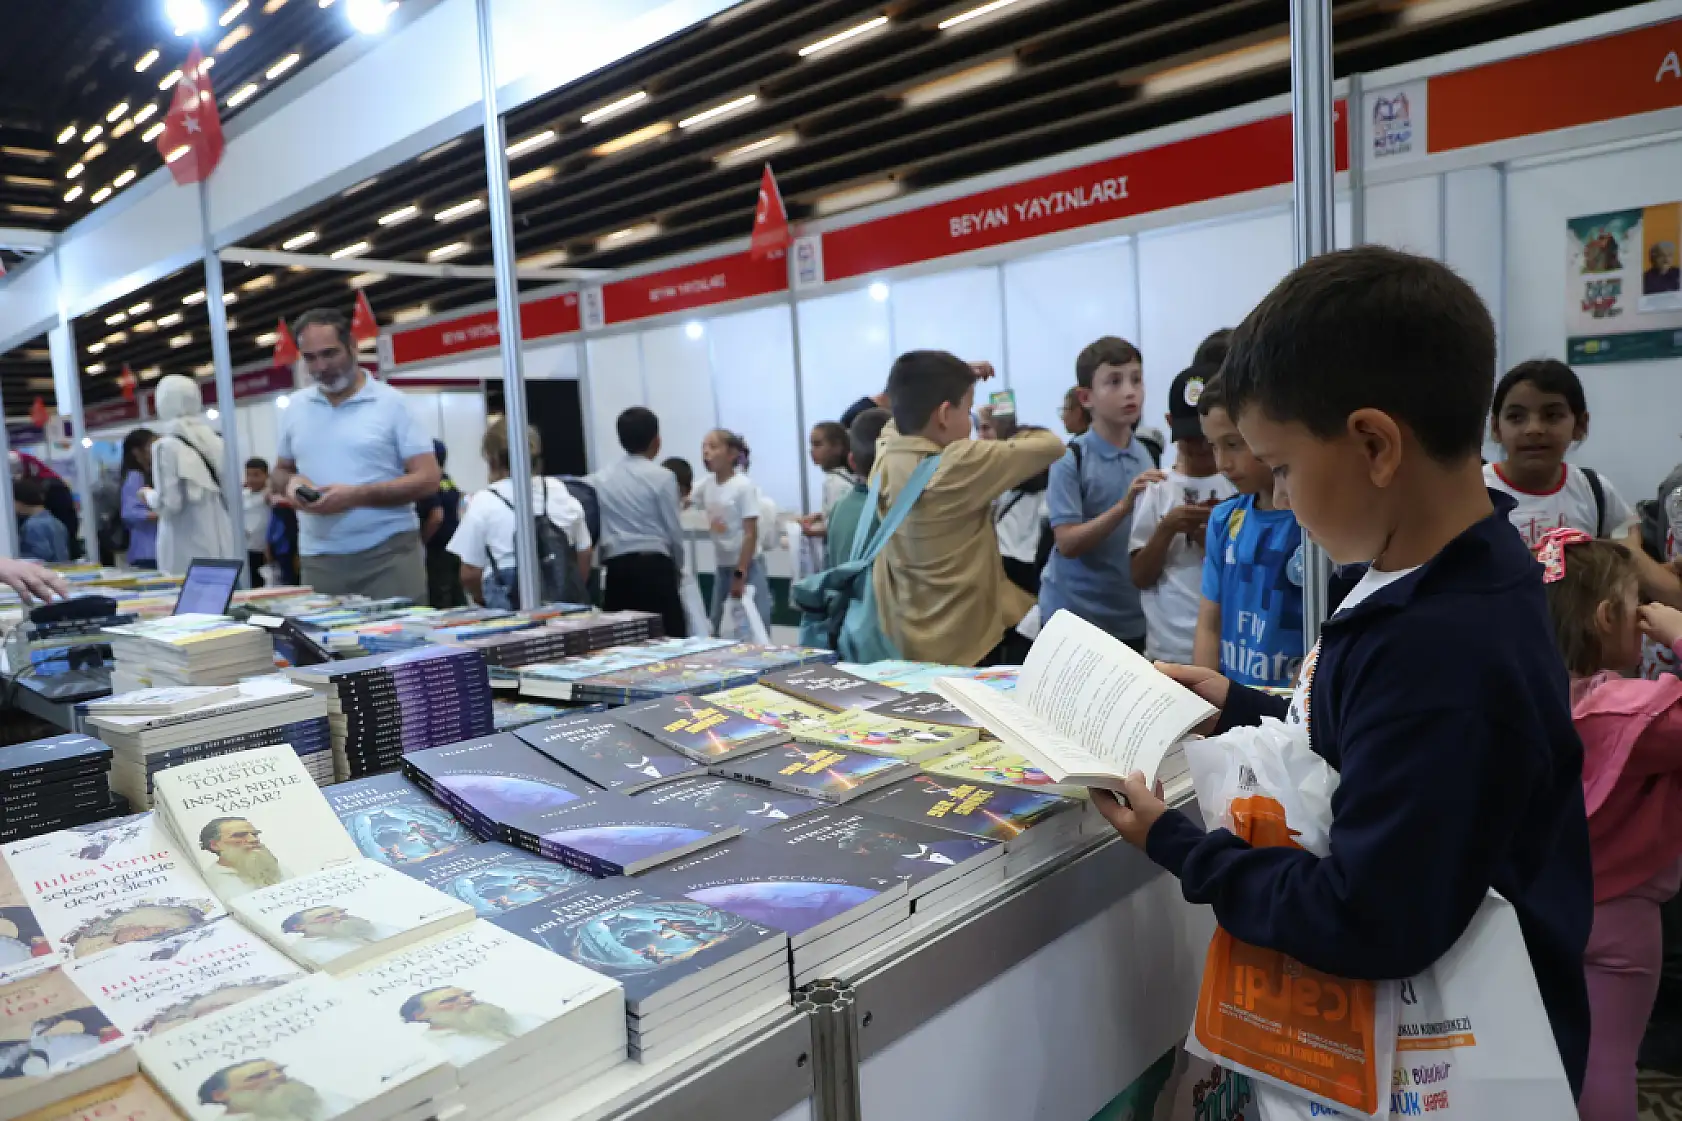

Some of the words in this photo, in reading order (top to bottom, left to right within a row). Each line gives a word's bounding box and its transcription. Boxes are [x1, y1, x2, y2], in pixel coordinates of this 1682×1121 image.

[949, 205, 1009, 237] BEYAN
[1013, 175, 1129, 221] YAYINLARI
[1238, 610, 1266, 644] Fly
[187, 763, 277, 790] TOLSTOY
[245, 774, 302, 794] NEYLE
[34, 868, 97, 894] Jules
[101, 851, 170, 872] Verne
[42, 878, 109, 903] seksen
[112, 862, 176, 886] günde
